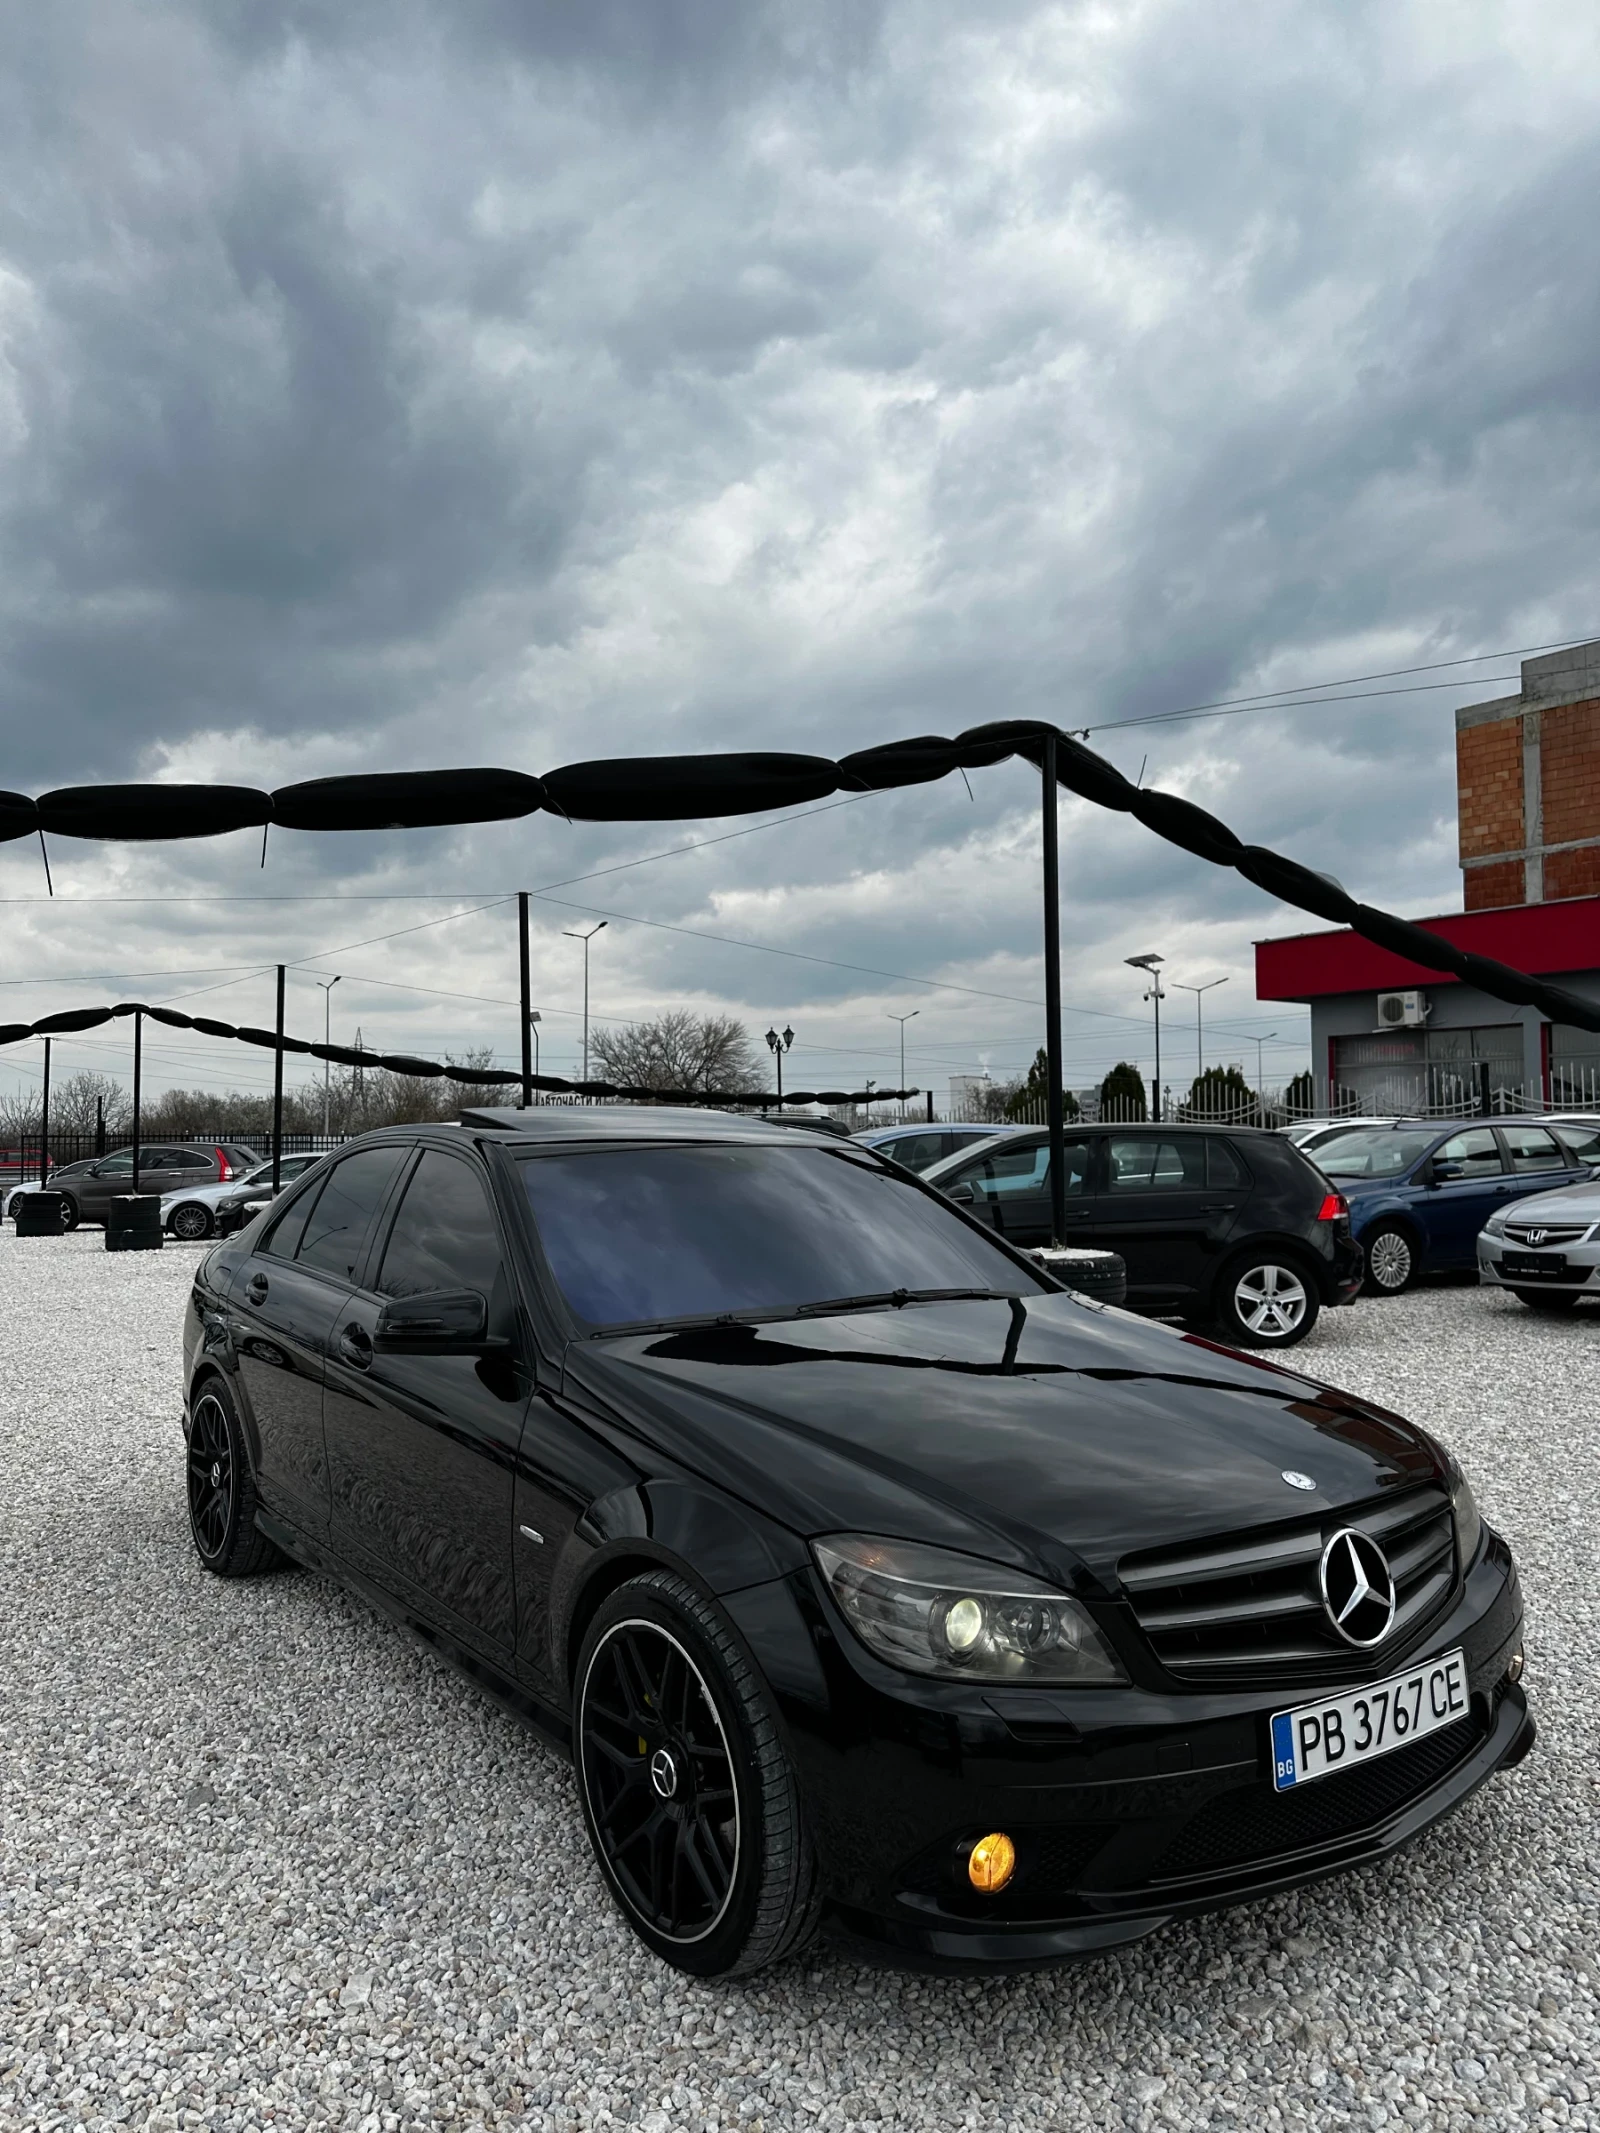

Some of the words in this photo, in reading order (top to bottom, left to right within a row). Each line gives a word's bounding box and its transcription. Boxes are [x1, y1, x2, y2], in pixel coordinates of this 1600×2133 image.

[1299, 1708, 1346, 1771] PB
[1353, 1676, 1423, 1751] 3767
[1429, 1660, 1464, 1718] CE
[1277, 1759, 1294, 1777] BG
